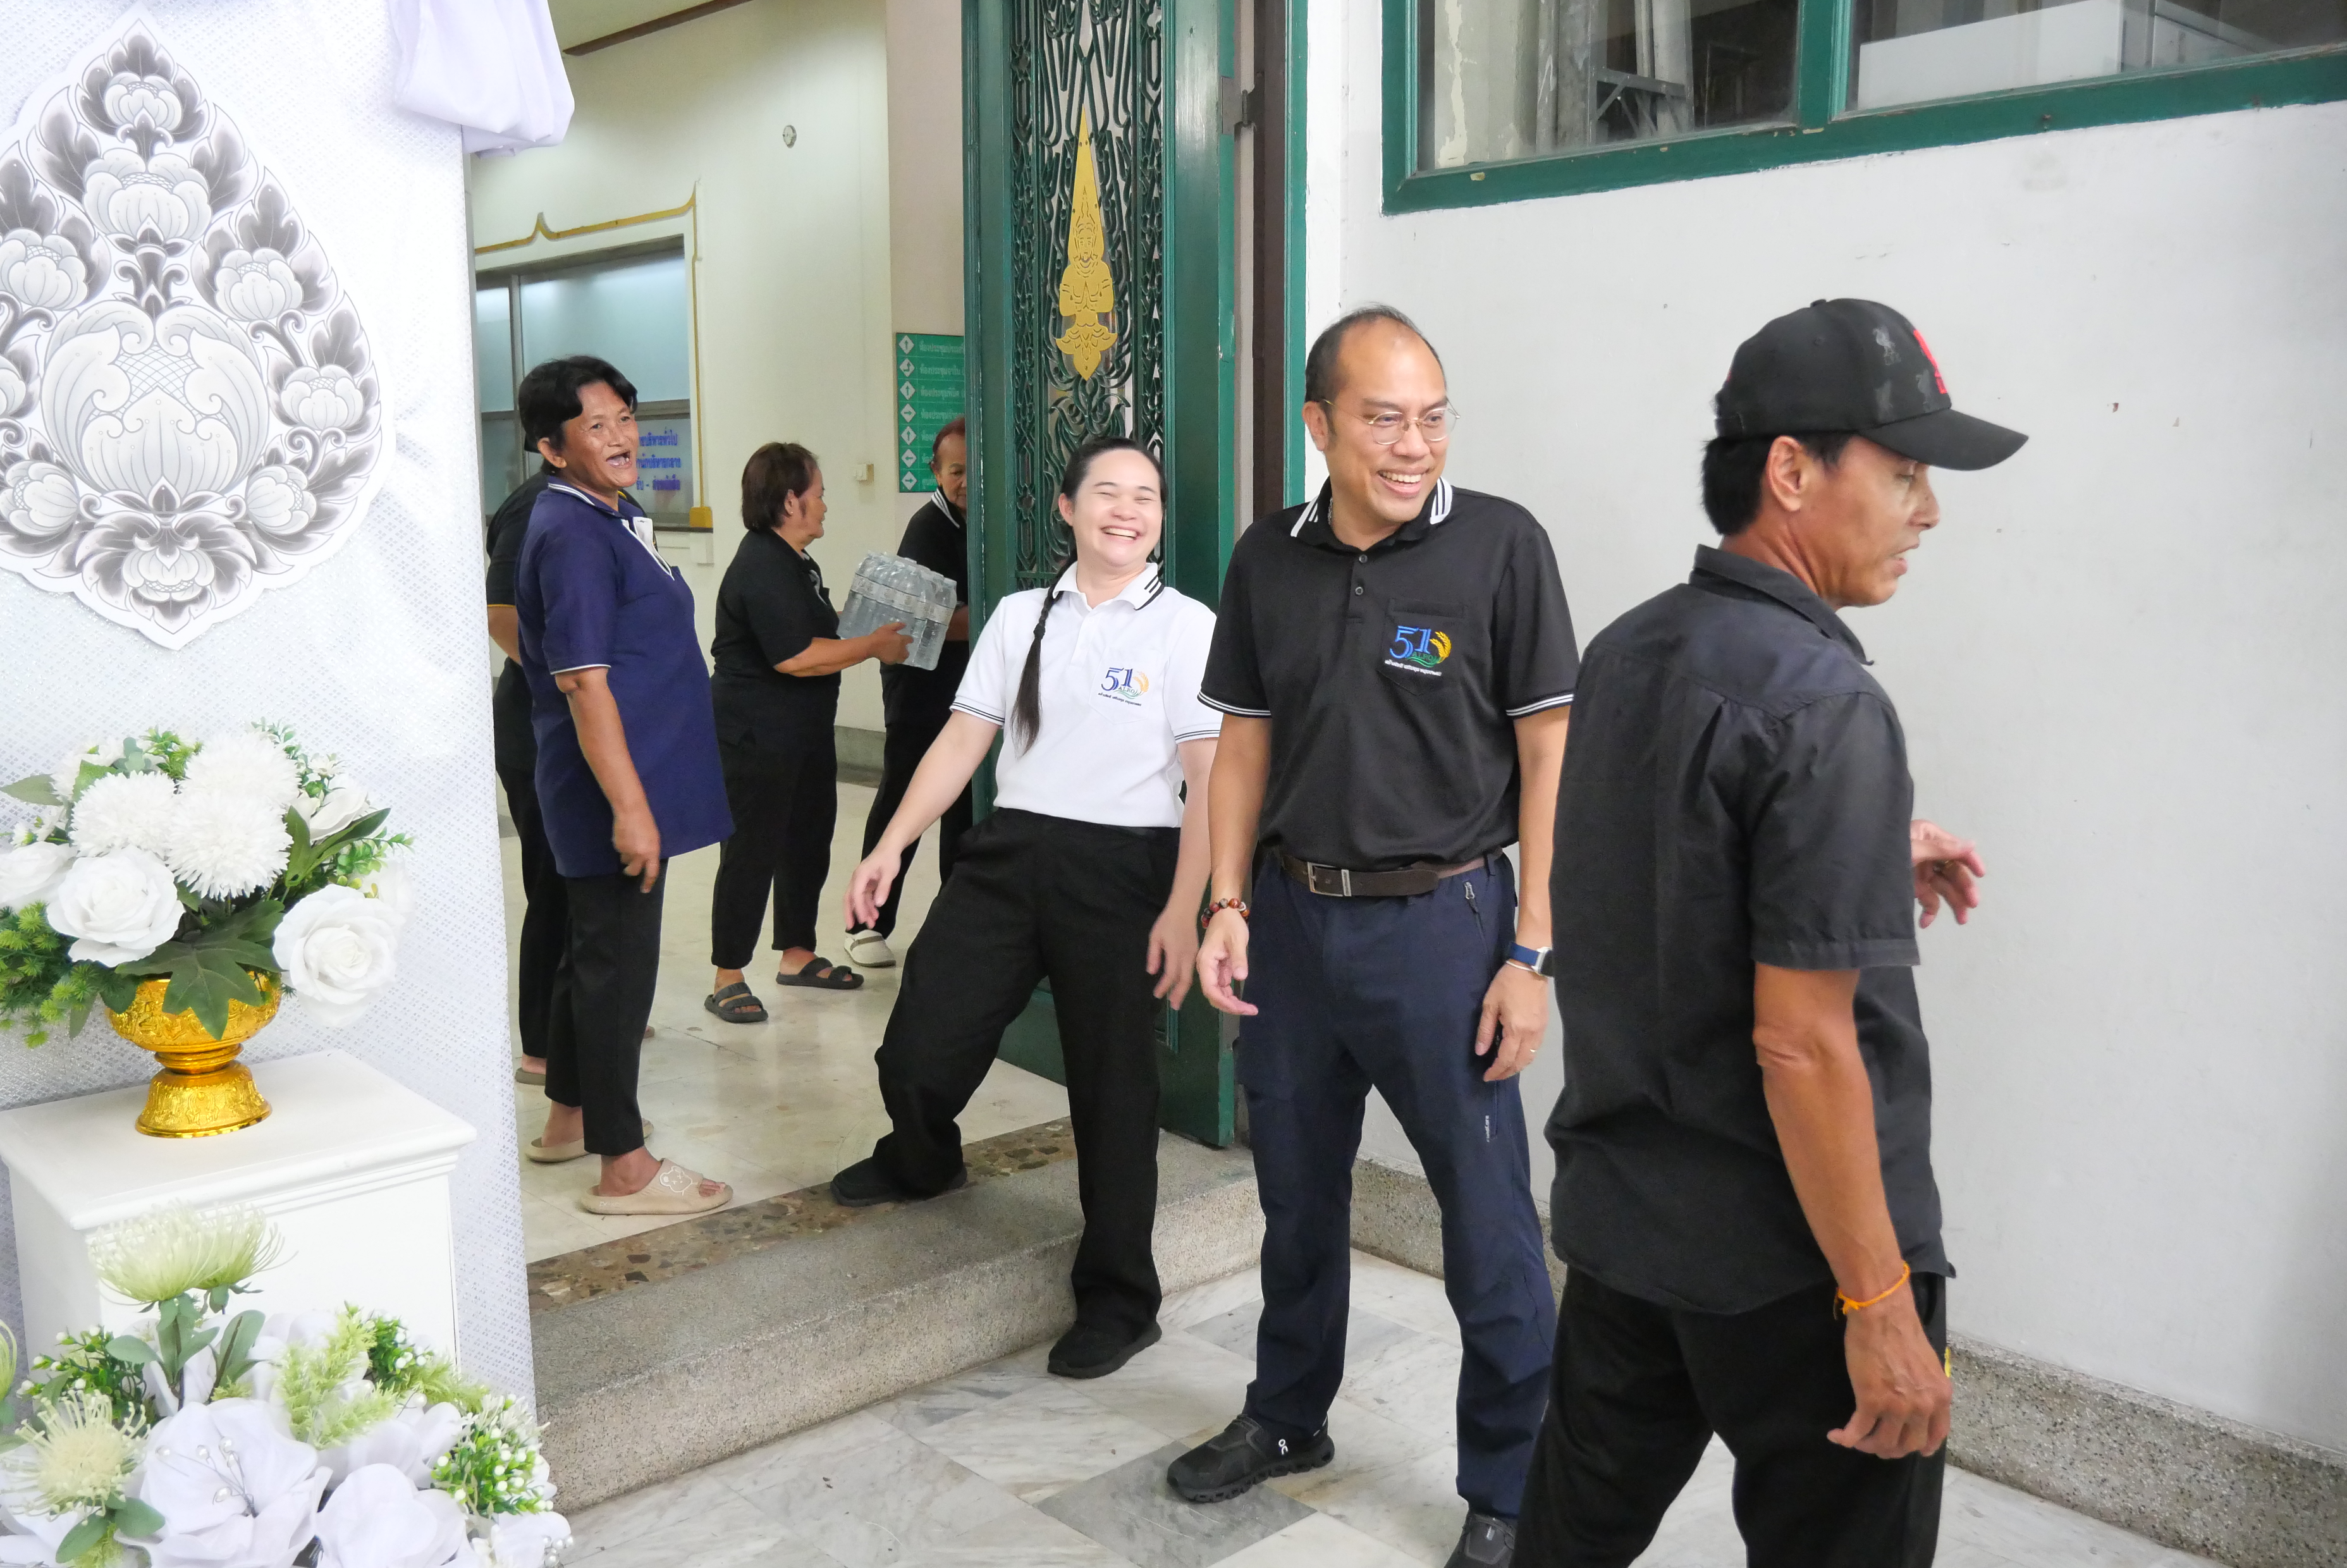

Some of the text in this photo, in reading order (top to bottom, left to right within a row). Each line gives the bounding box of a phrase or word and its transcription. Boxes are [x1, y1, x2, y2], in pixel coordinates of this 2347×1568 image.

[1389, 625, 1432, 659] 51
[1101, 667, 1134, 691] 51
[1118, 686, 1136, 694] ALRO
